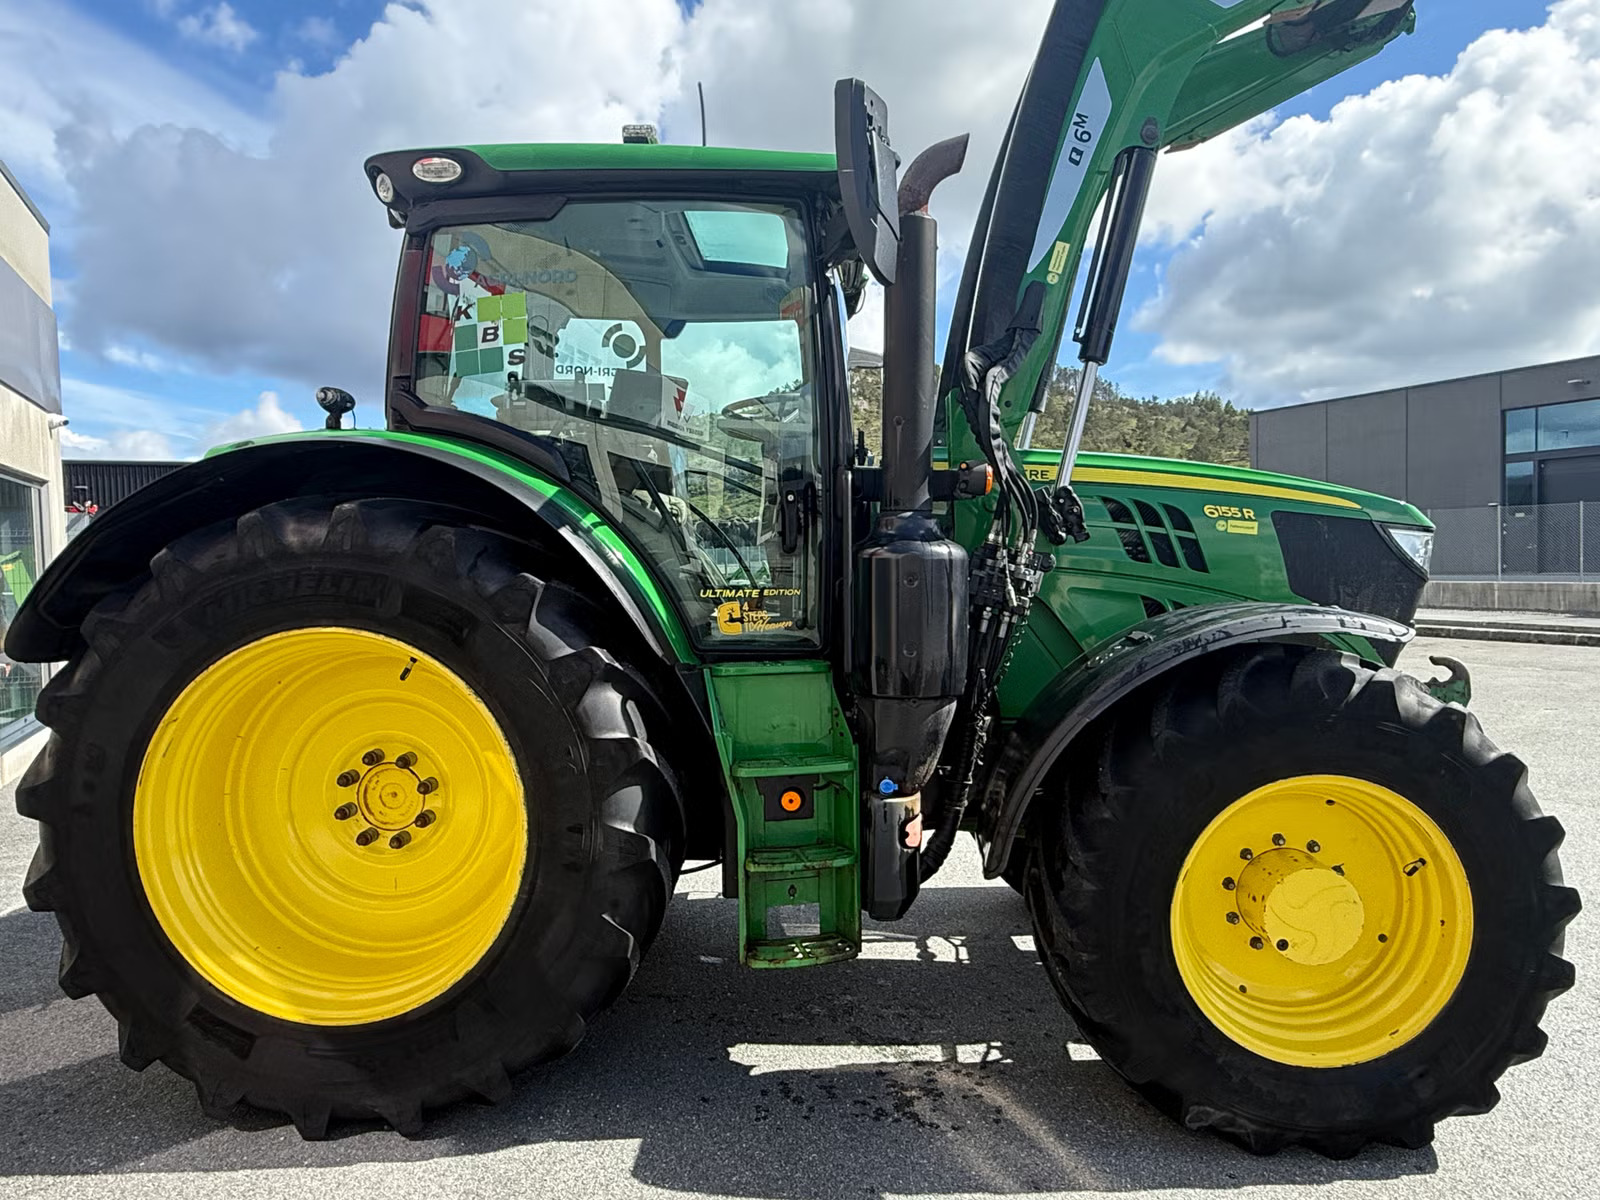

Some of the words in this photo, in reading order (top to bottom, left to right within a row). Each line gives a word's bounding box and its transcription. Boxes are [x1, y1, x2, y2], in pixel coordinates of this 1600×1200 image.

[481, 326, 500, 343] B
[508, 348, 526, 366] S
[1203, 504, 1242, 518] 6155
[1242, 508, 1256, 520] R
[699, 589, 760, 598] ULTIMATE
[763, 588, 801, 596] EDITION
[742, 601, 749, 611] 4
[743, 610, 768, 622] STEPS
